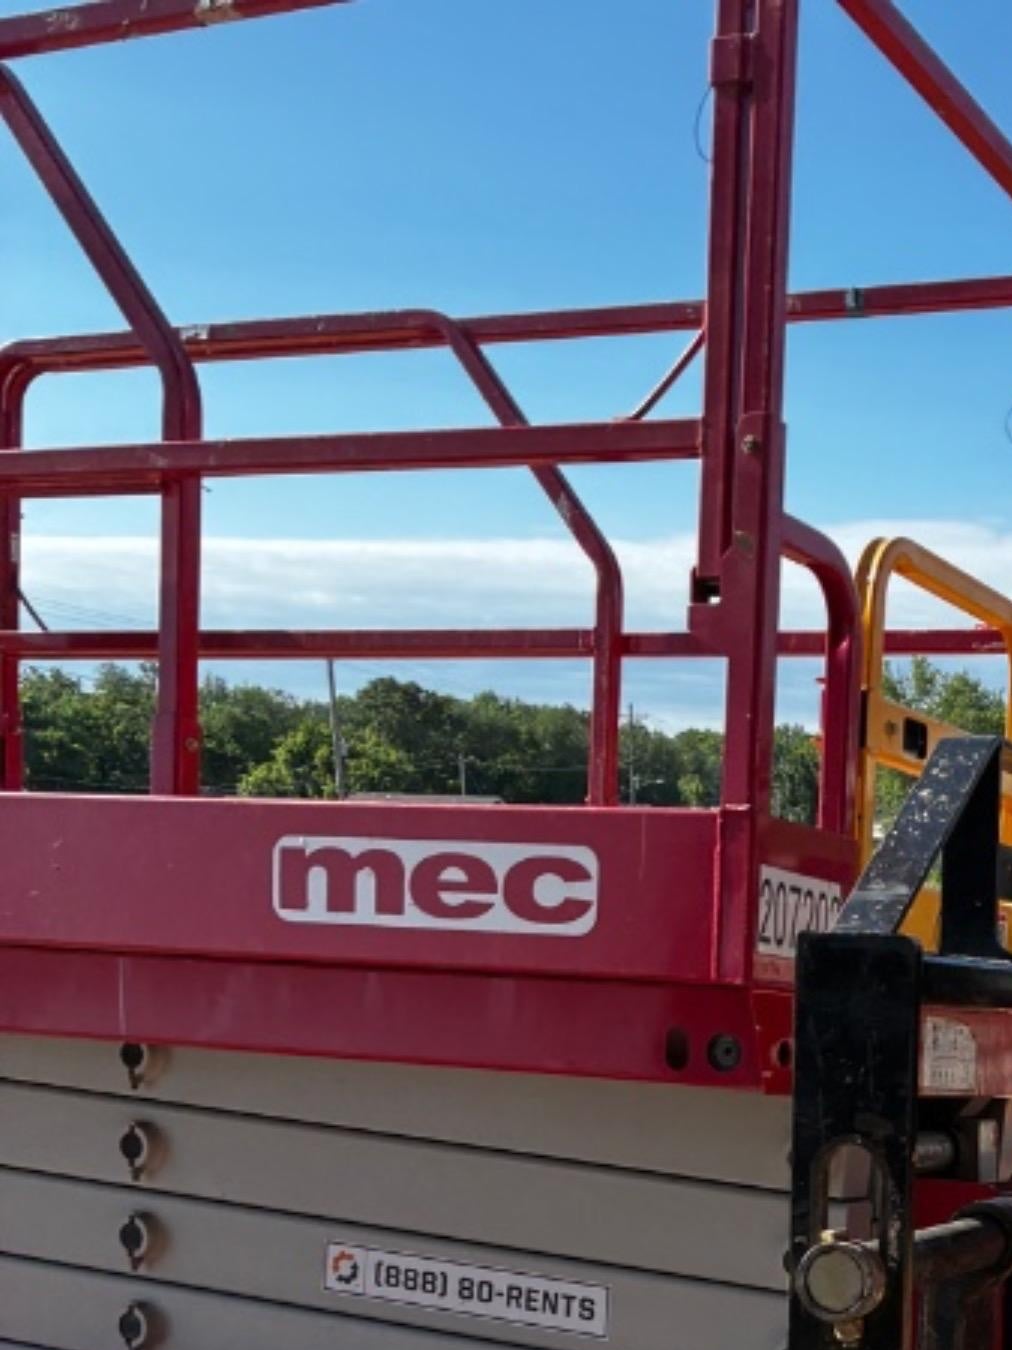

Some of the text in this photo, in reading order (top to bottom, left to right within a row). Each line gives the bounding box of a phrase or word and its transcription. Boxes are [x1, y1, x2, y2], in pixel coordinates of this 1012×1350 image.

[279, 846, 594, 925] mec
[759, 878, 841, 948] 20720
[374, 1260, 596, 1321] (888) 80-RENTS
